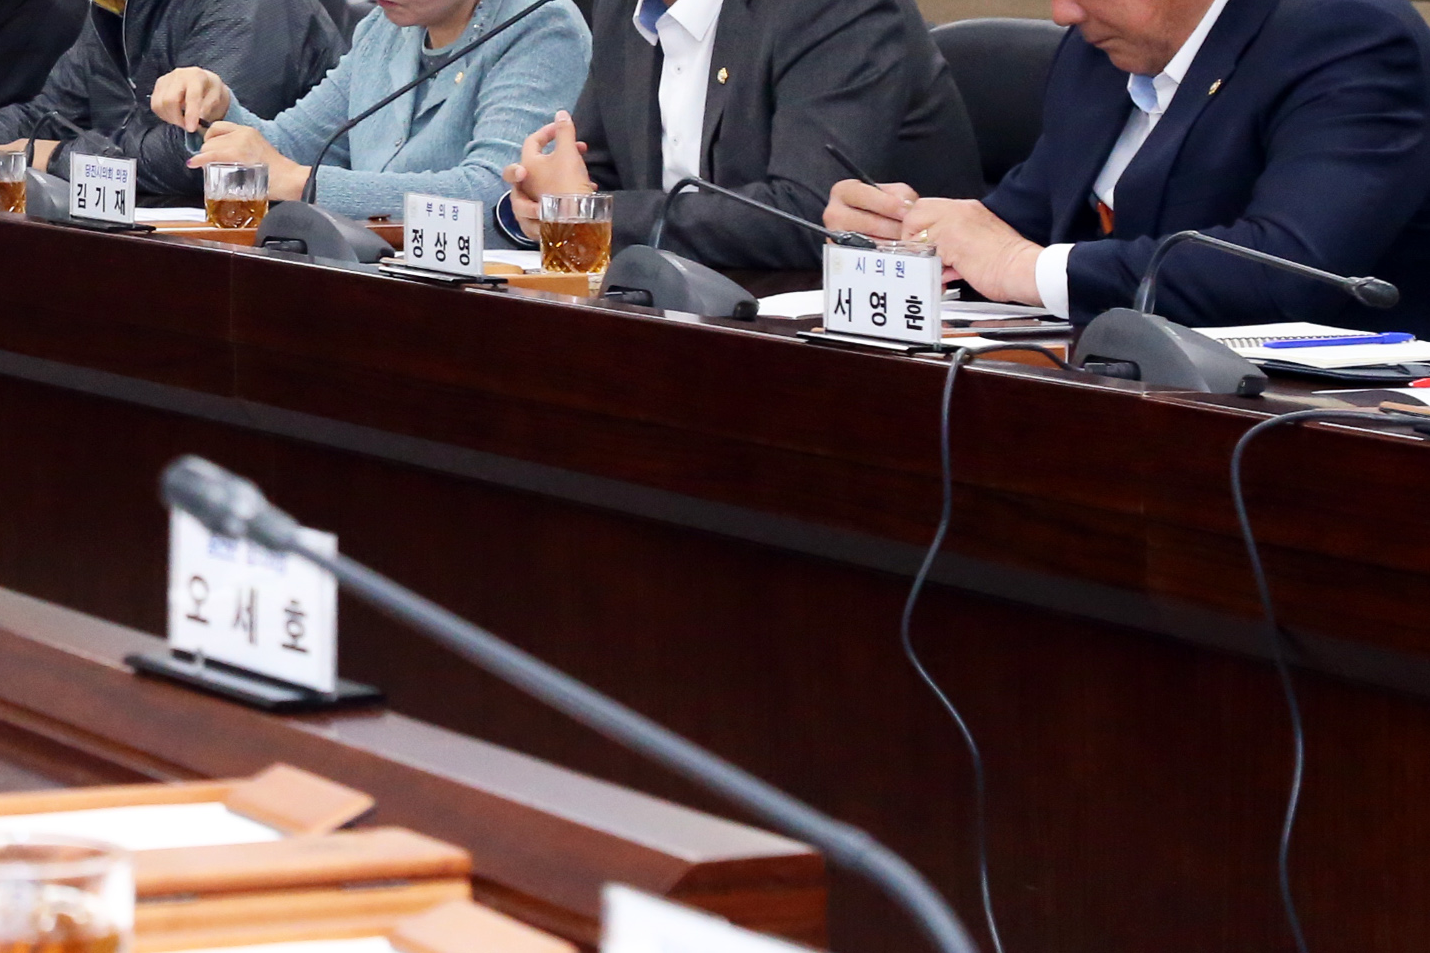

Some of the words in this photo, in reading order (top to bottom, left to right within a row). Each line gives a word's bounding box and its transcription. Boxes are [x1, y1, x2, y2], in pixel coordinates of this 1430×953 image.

[77, 183, 126, 216] 김기재
[411, 228, 471, 266] 정상영
[856, 257, 905, 278] 시의원
[834, 288, 925, 331] 서영훈
[186, 573, 309, 654] 오세호
